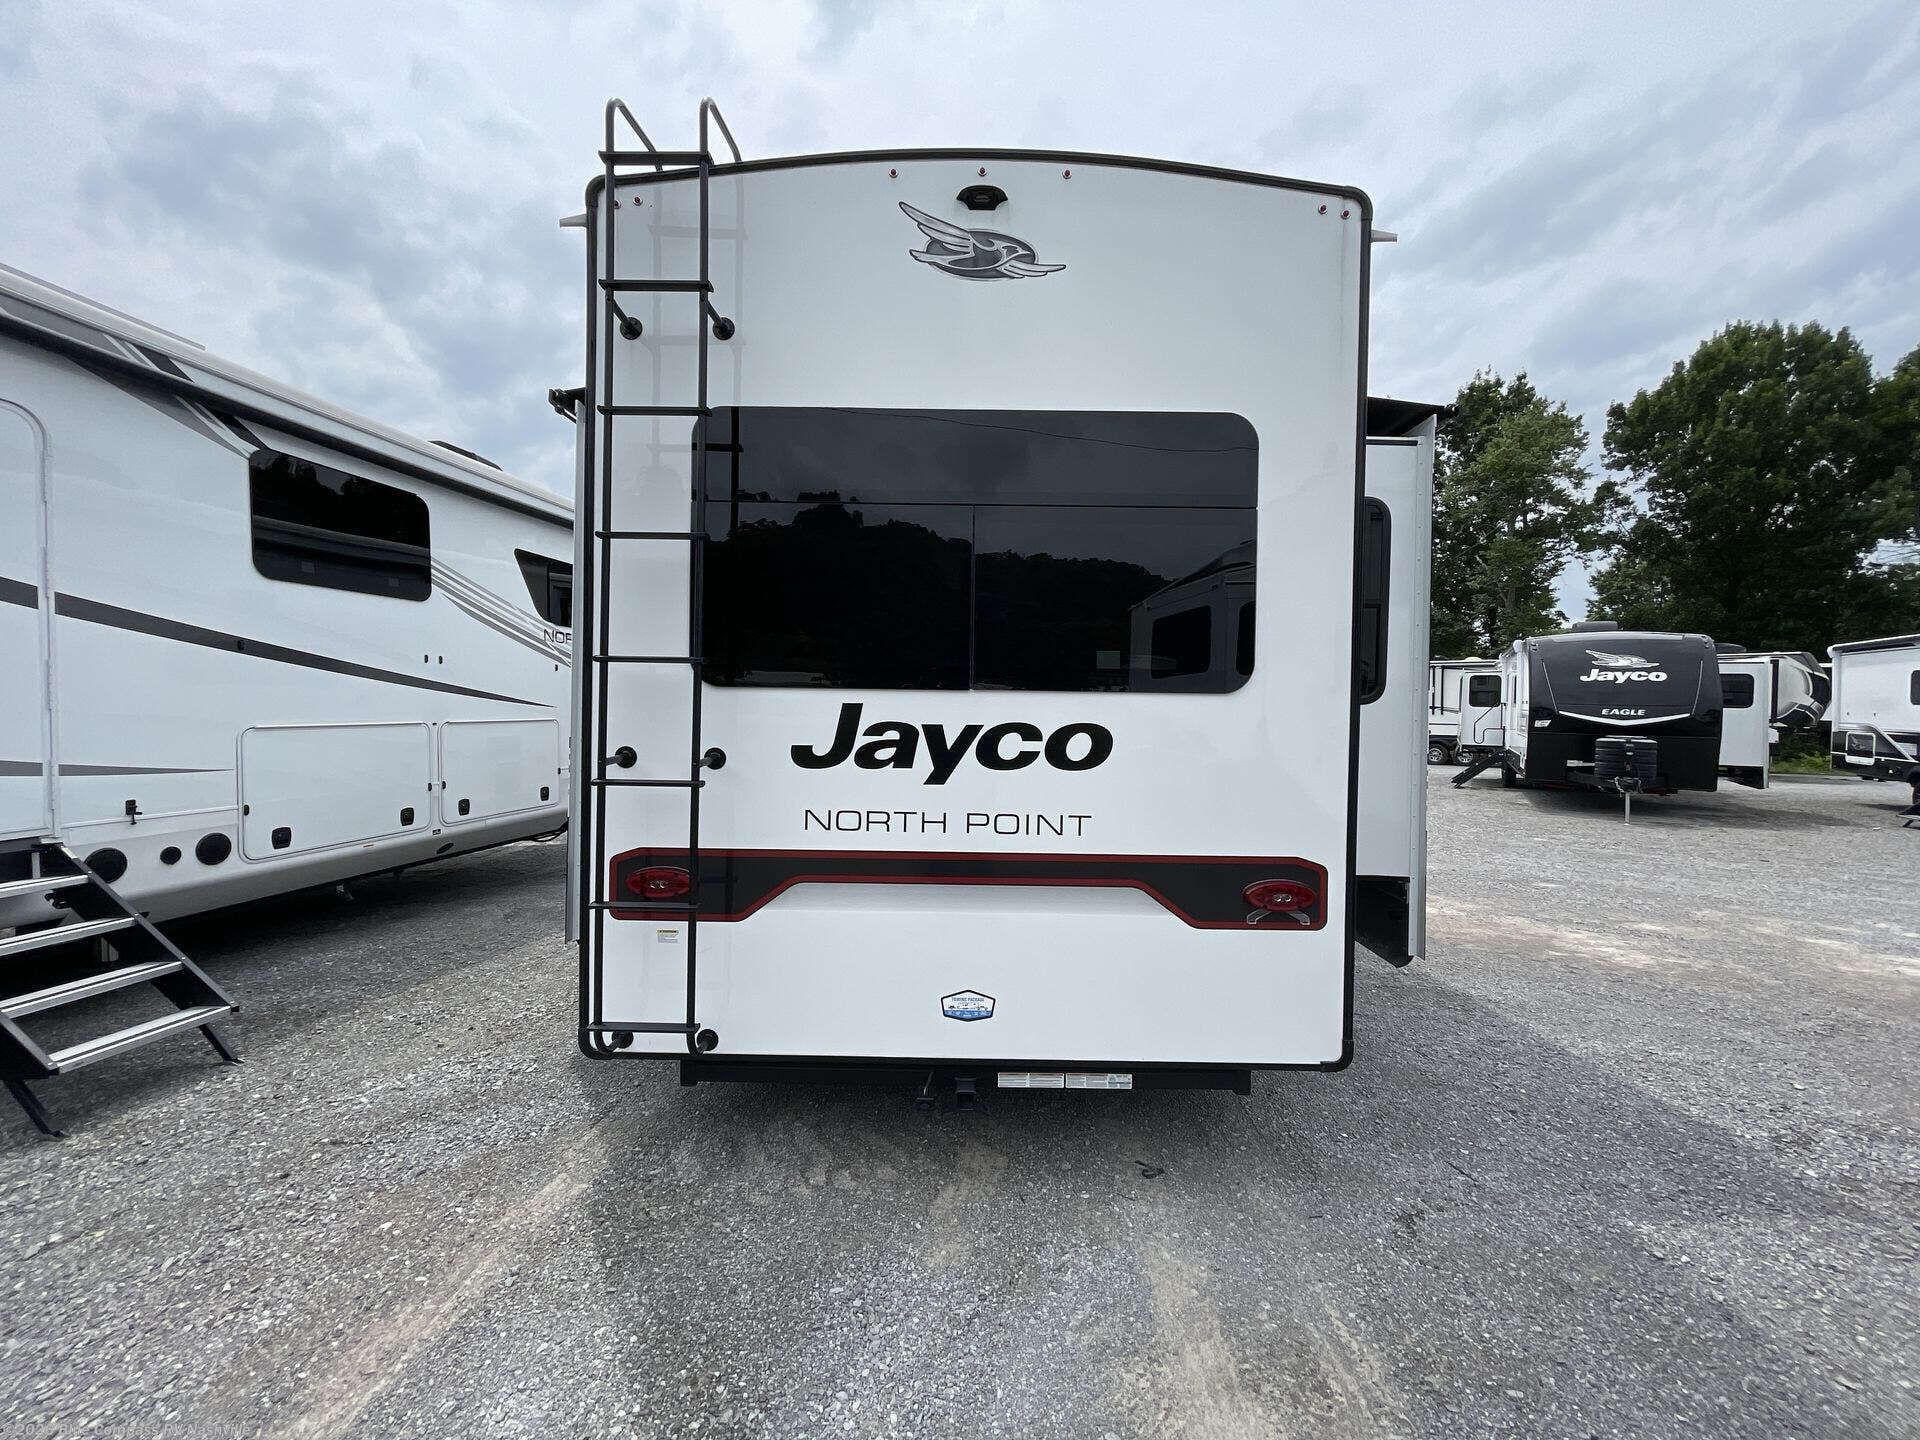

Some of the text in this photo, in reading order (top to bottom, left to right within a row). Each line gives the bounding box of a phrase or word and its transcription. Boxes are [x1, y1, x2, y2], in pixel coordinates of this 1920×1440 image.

[1580, 669, 1668, 683] Jayco
[1602, 708, 1646, 716] EAGLE
[791, 702, 1113, 786] Jayco
[804, 809, 1092, 837] NORTH POINT
